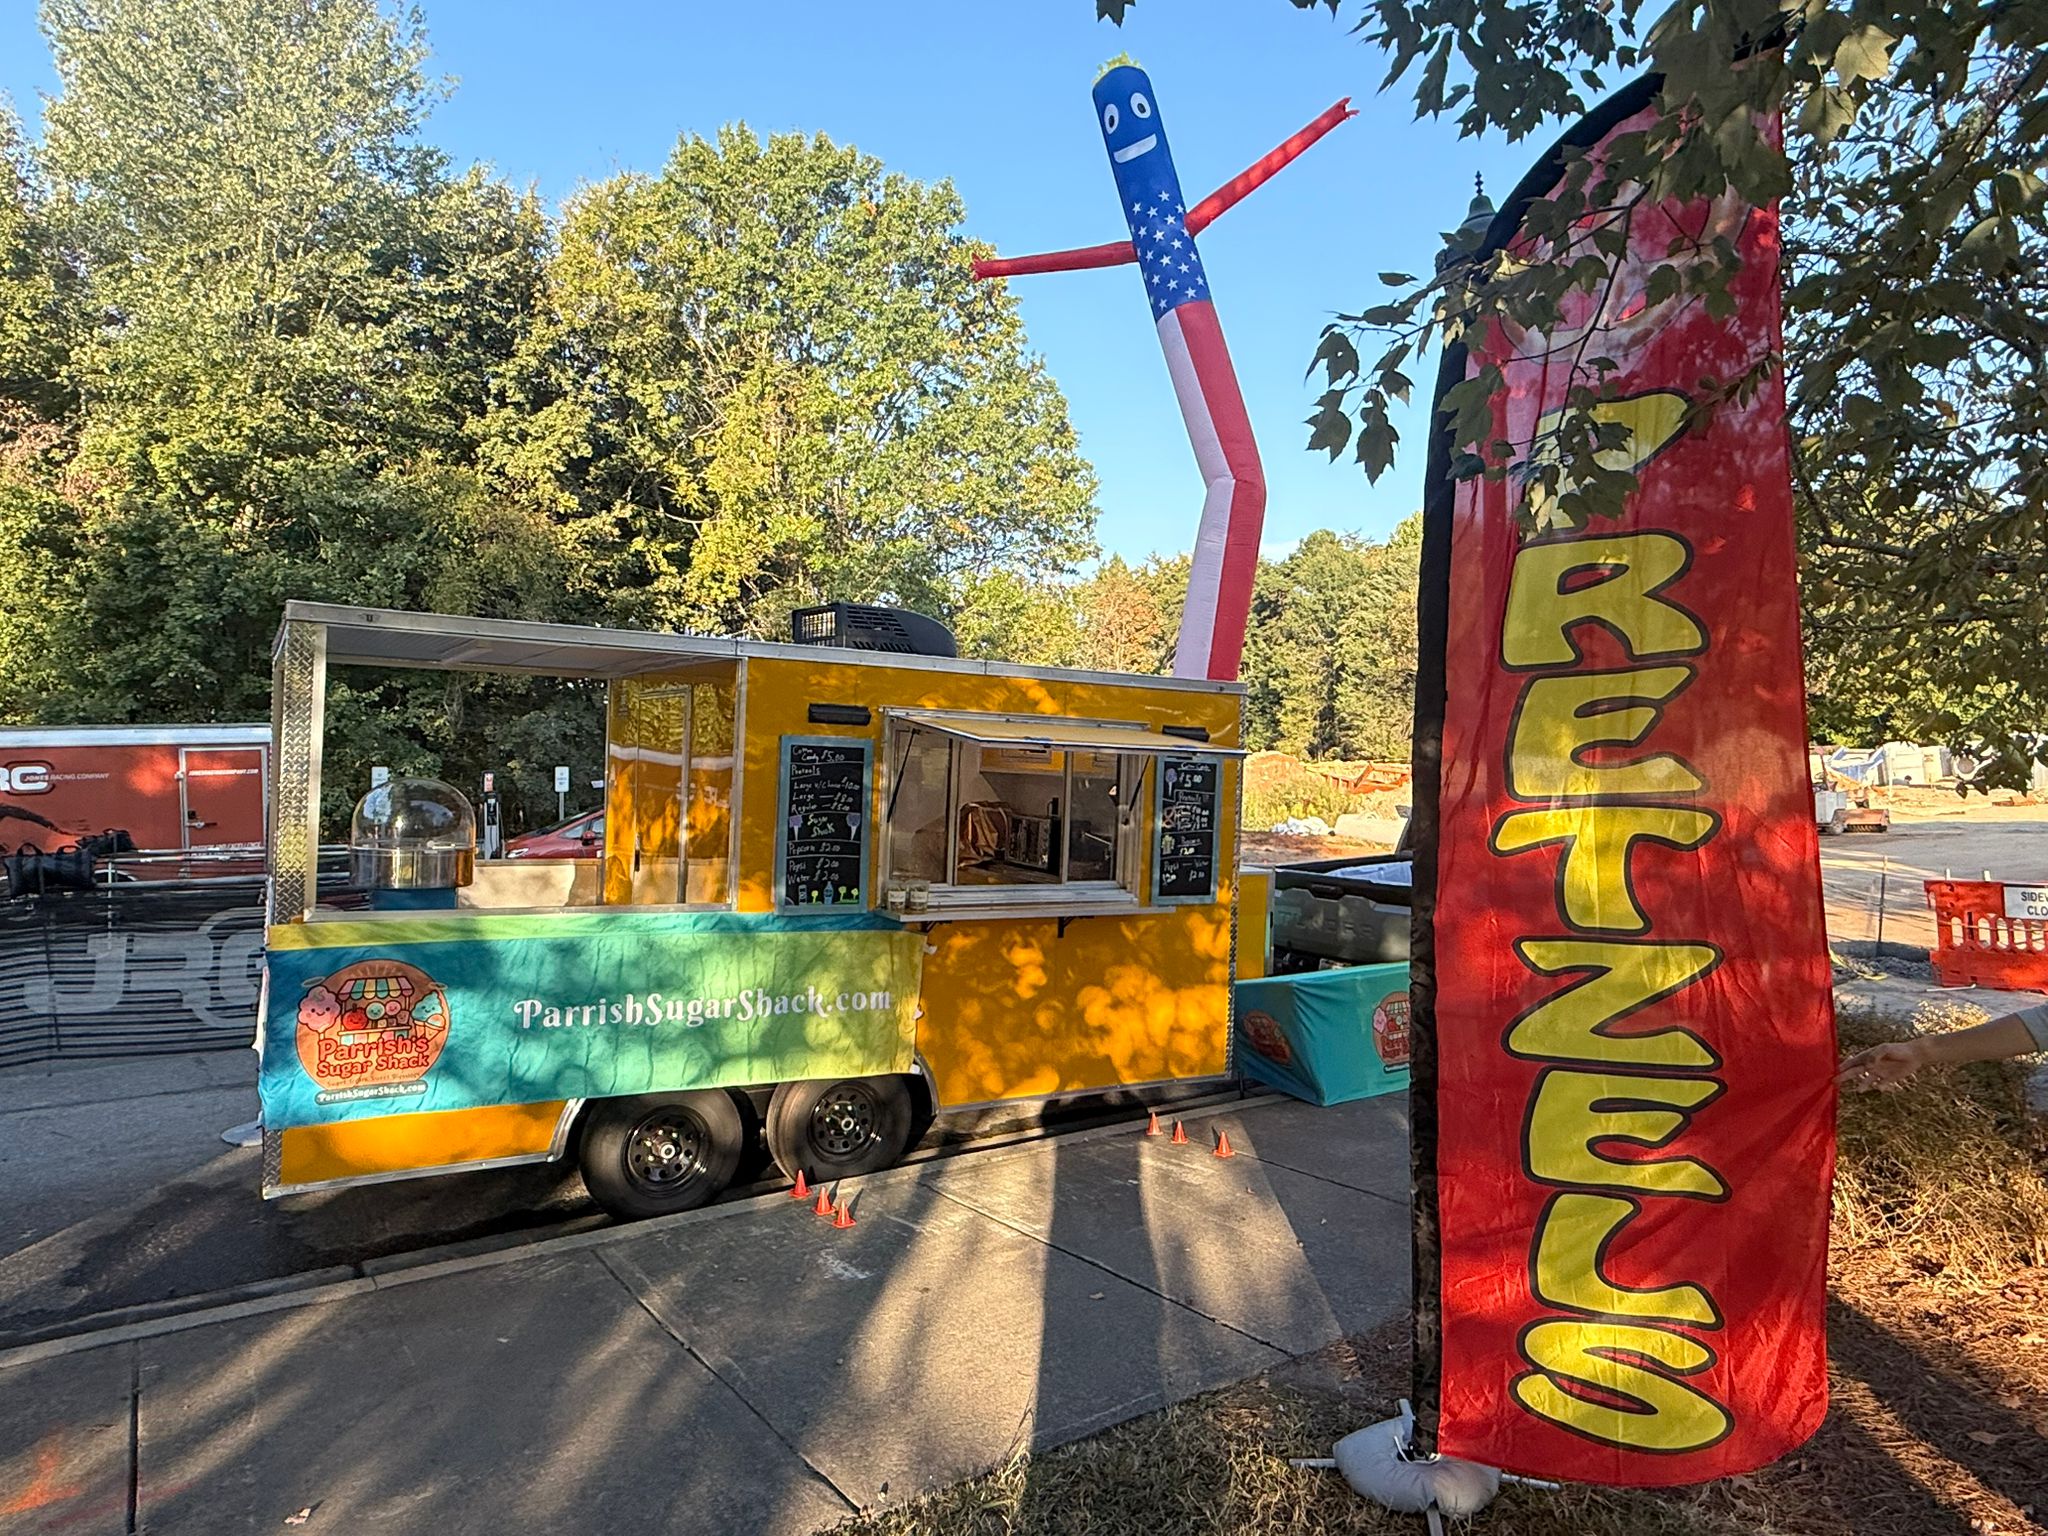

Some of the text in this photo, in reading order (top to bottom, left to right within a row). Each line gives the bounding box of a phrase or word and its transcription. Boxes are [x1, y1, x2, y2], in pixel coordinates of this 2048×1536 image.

[792, 792, 814, 802] Large
[1489, 387, 1735, 1455] PRETZELS
[513, 986, 891, 1029] ParrishSugarShack.com
[318, 1036, 429, 1061] Parrish's
[317, 1059, 372, 1078] Sugar
[376, 1053, 429, 1071] Shack
[318, 1084, 426, 1101] ParrishSugarShack.com
